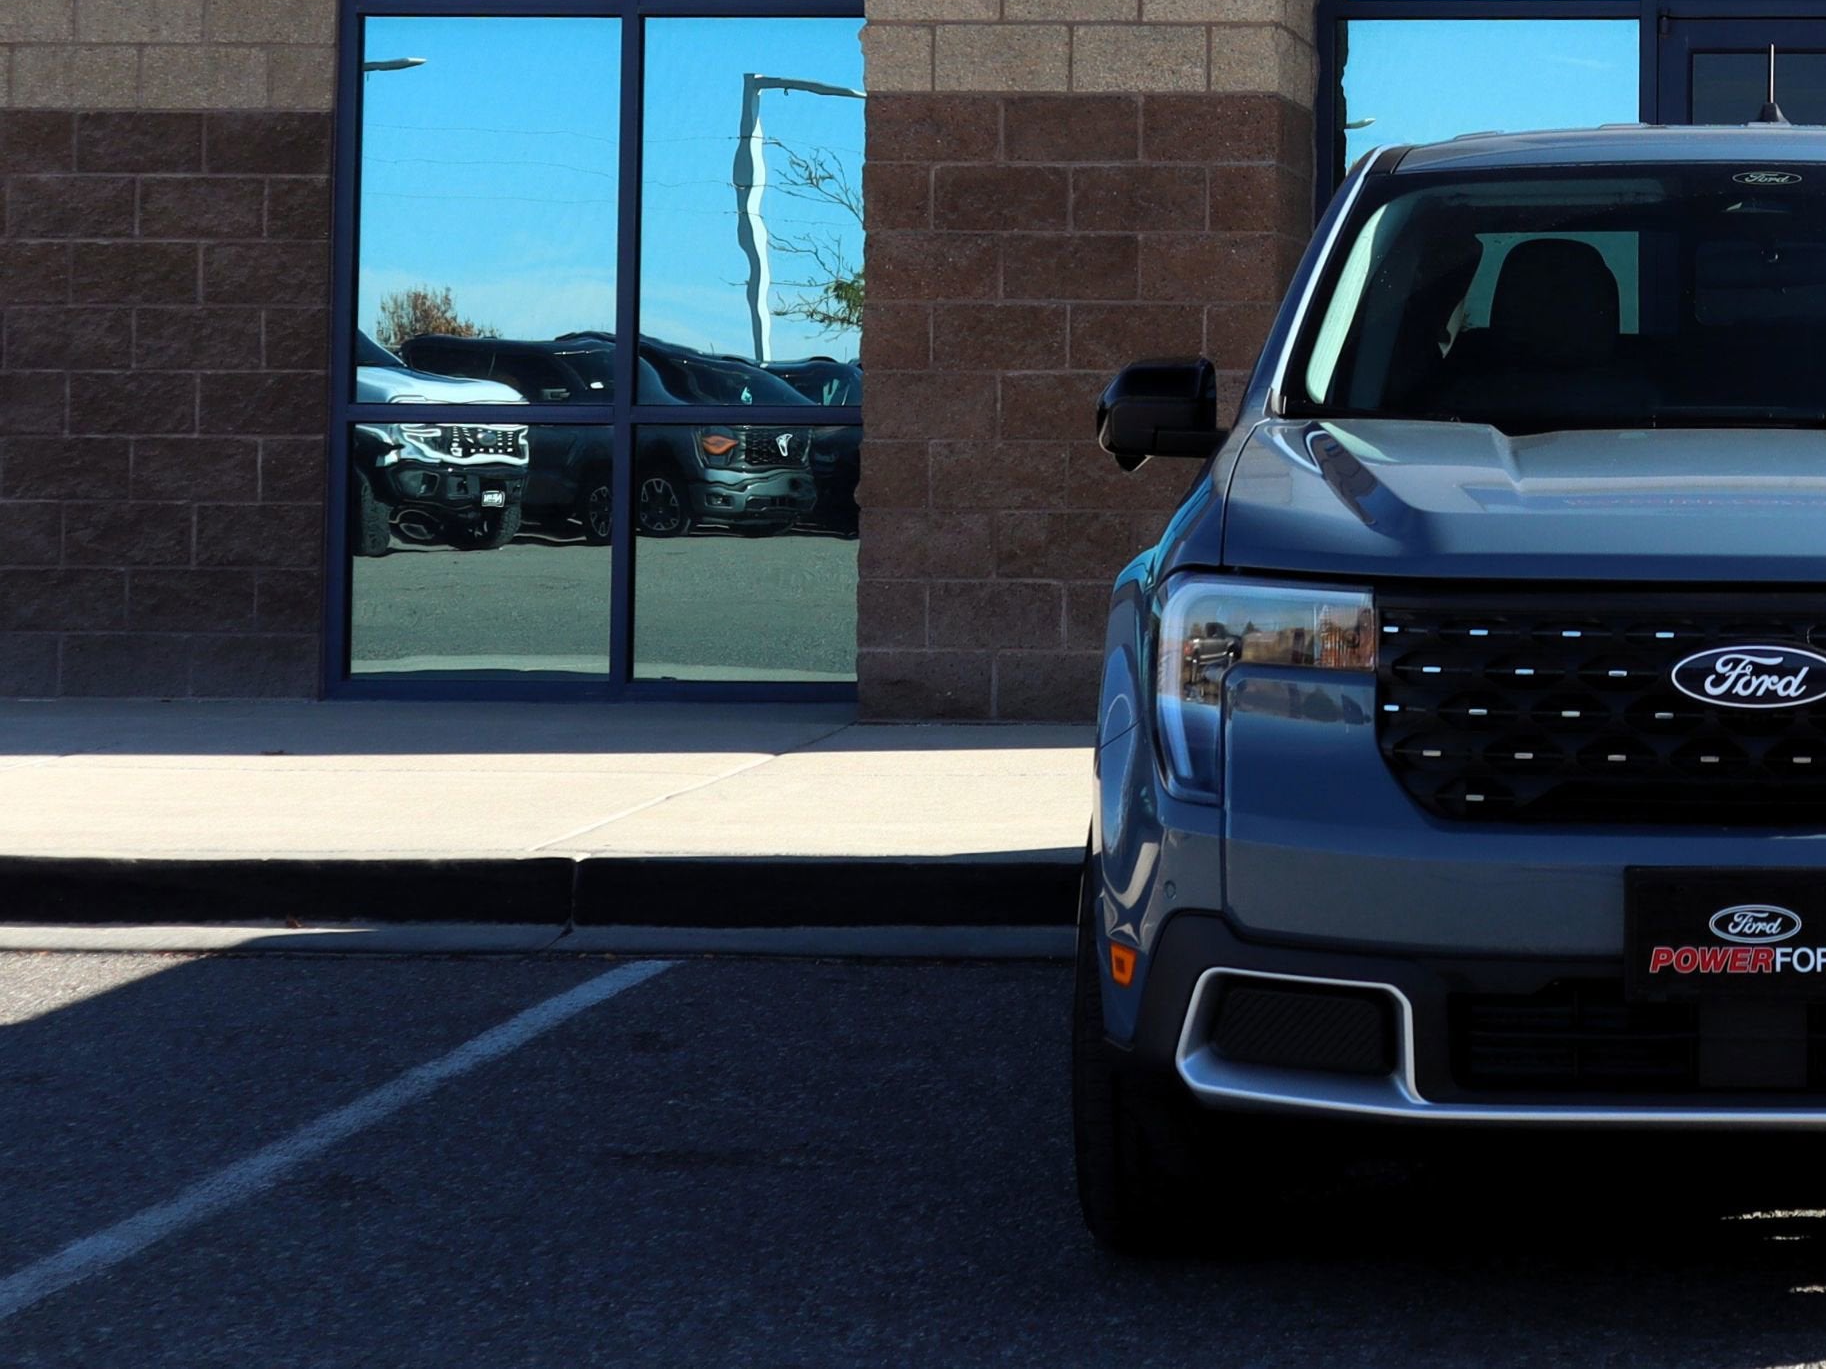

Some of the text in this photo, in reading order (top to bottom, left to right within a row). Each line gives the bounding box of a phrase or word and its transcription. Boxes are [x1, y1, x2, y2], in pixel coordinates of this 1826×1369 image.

[1744, 173, 1790, 184] Ford
[1704, 653, 1810, 699] Ford
[1727, 911, 1783, 936] Ford
